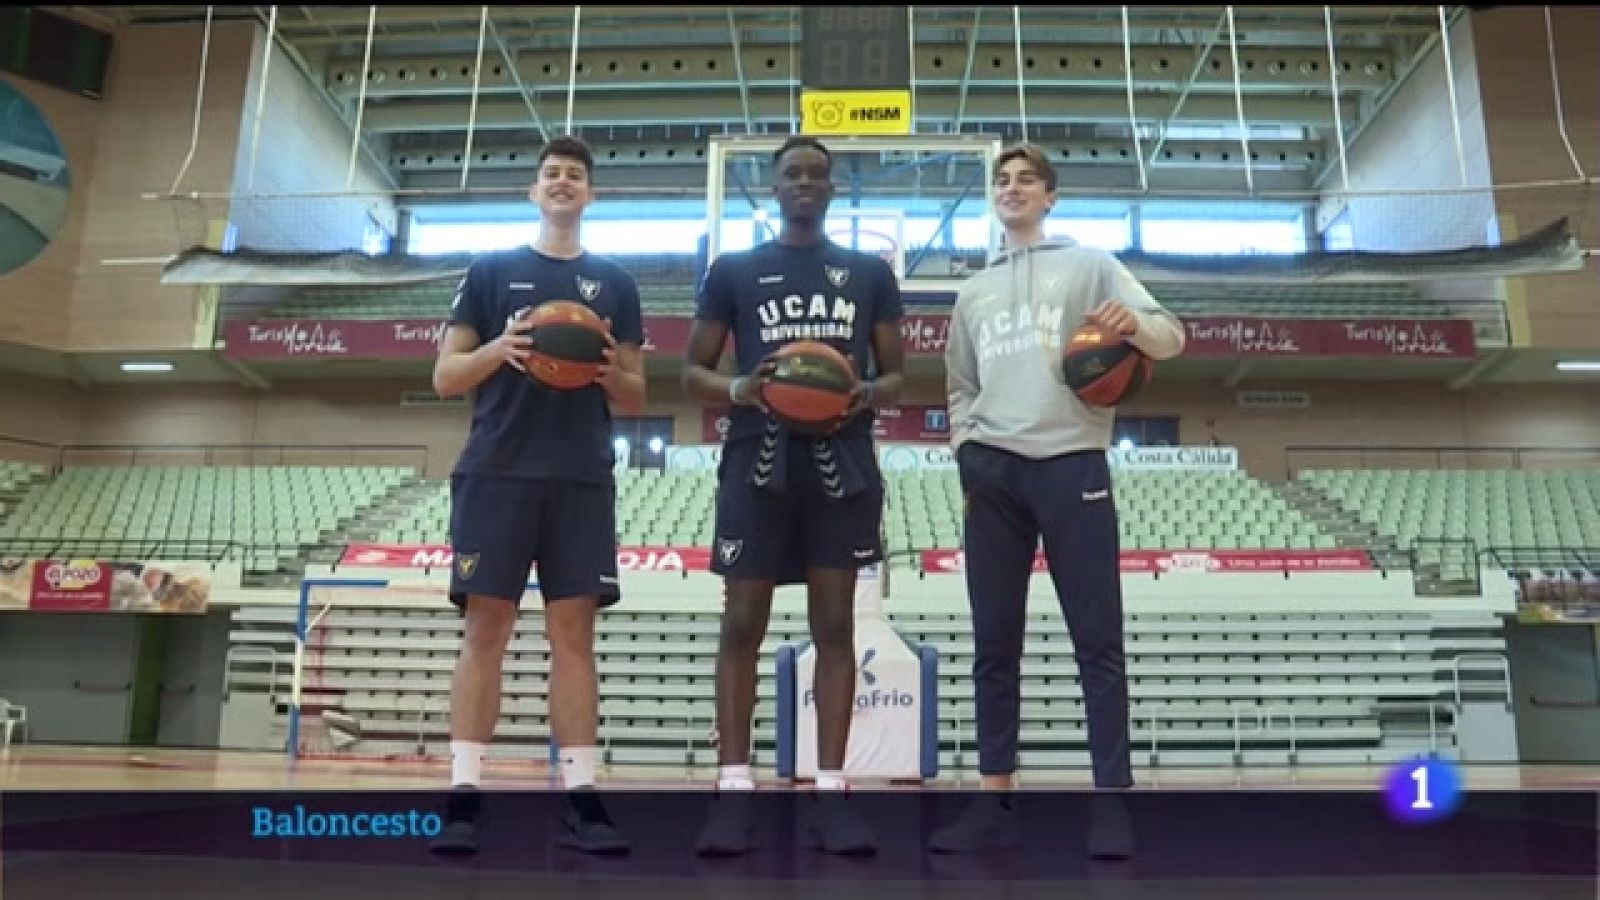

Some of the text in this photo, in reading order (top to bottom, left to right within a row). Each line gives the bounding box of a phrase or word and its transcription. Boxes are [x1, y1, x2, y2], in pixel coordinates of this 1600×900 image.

[850, 106, 901, 122] #NSM
[757, 293, 856, 326] UCAM
[1124, 450, 1174, 465] Costa
